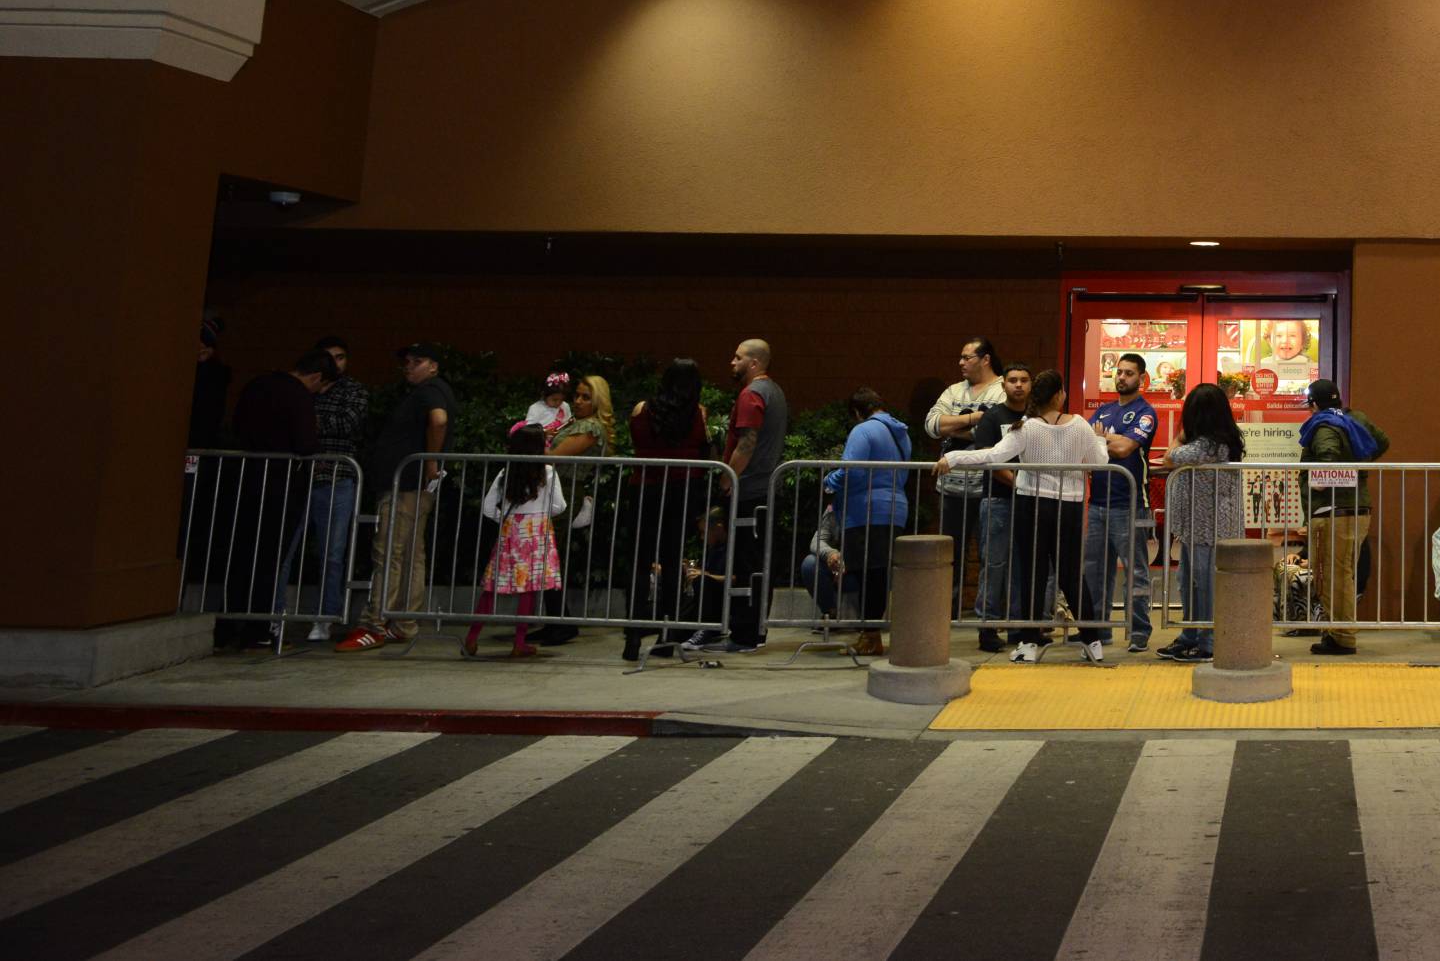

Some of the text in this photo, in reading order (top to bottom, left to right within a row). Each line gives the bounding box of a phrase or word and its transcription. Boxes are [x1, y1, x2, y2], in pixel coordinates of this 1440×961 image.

[1243, 427, 1295, 440] e're hiring.
[1310, 470, 1356, 479] NATIONAL
